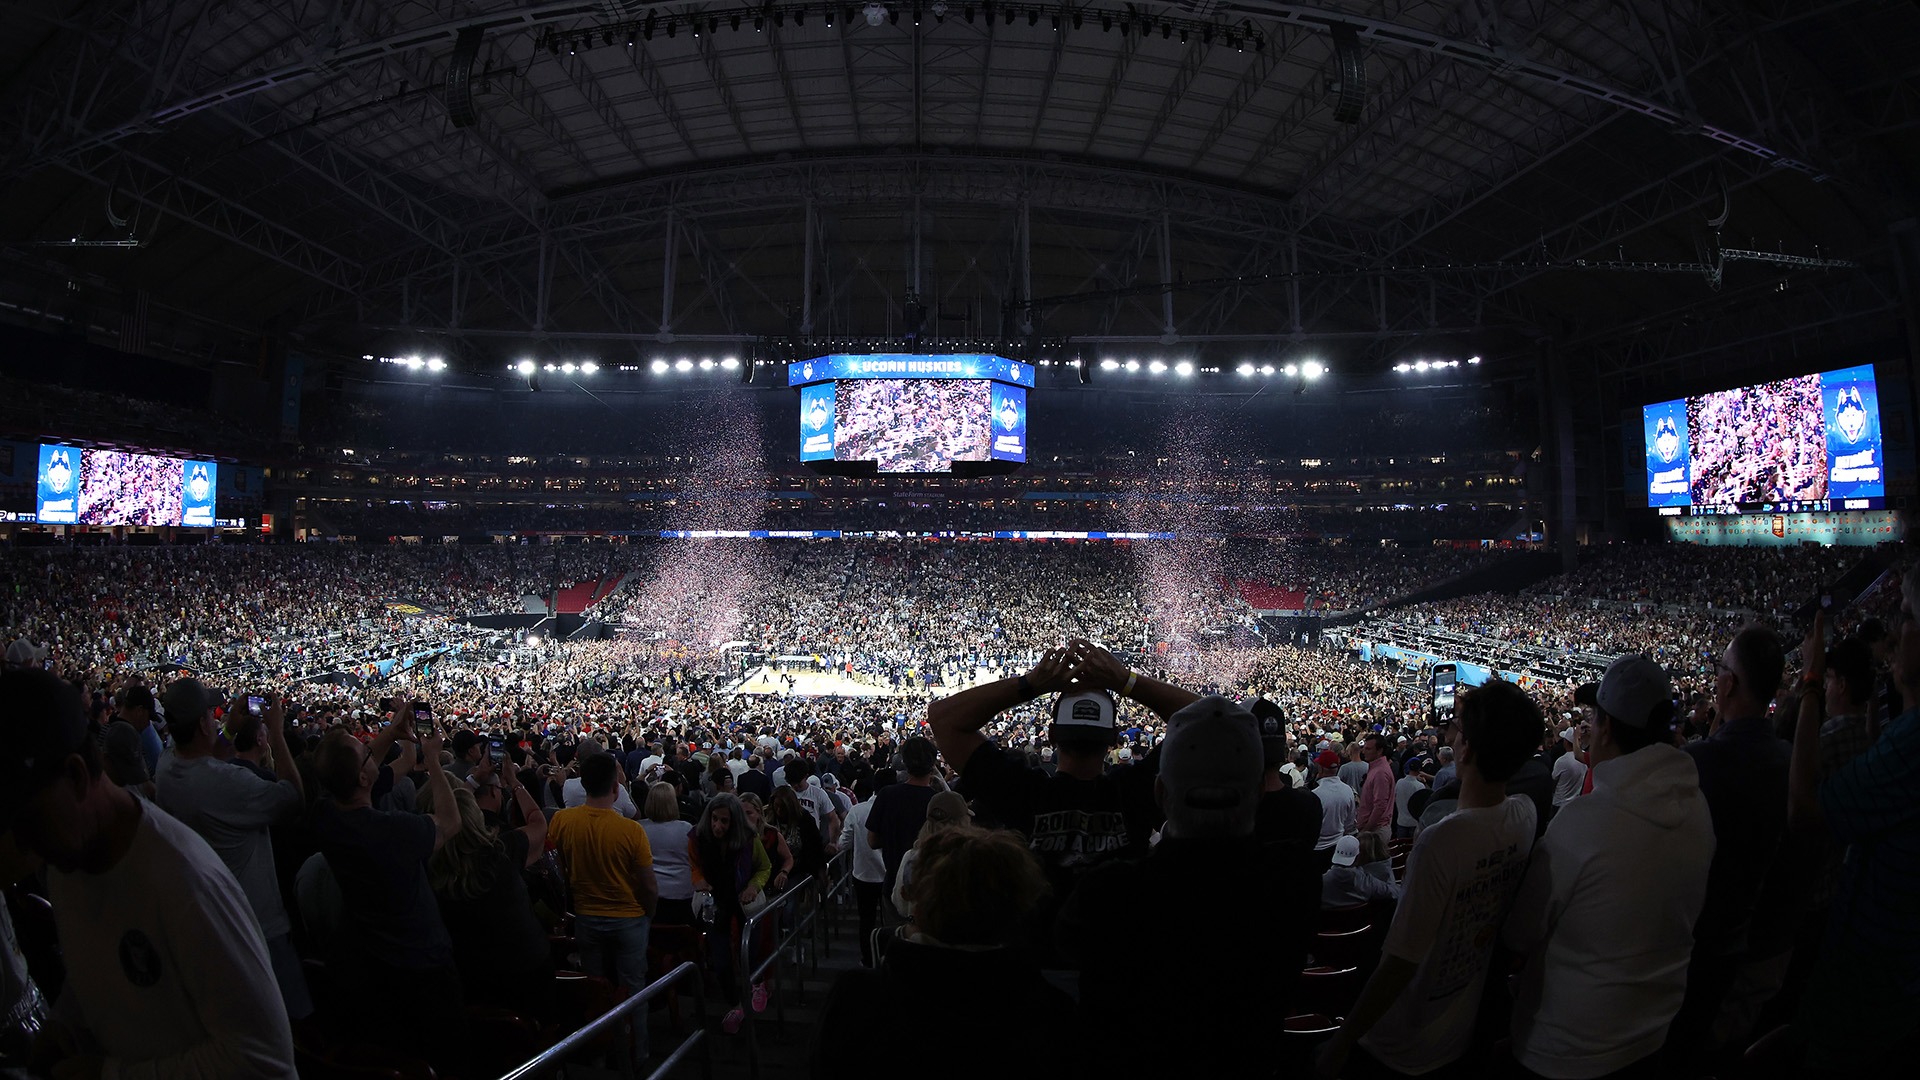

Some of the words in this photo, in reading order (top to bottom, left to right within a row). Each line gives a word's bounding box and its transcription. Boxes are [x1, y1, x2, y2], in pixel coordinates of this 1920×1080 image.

[862, 361, 906, 372] UCONN
[908, 361, 962, 372] HUSKIES
[1029, 835, 1068, 852] FOR
[1071, 833, 1083, 853] A
[1086, 832, 1130, 853] CURE
